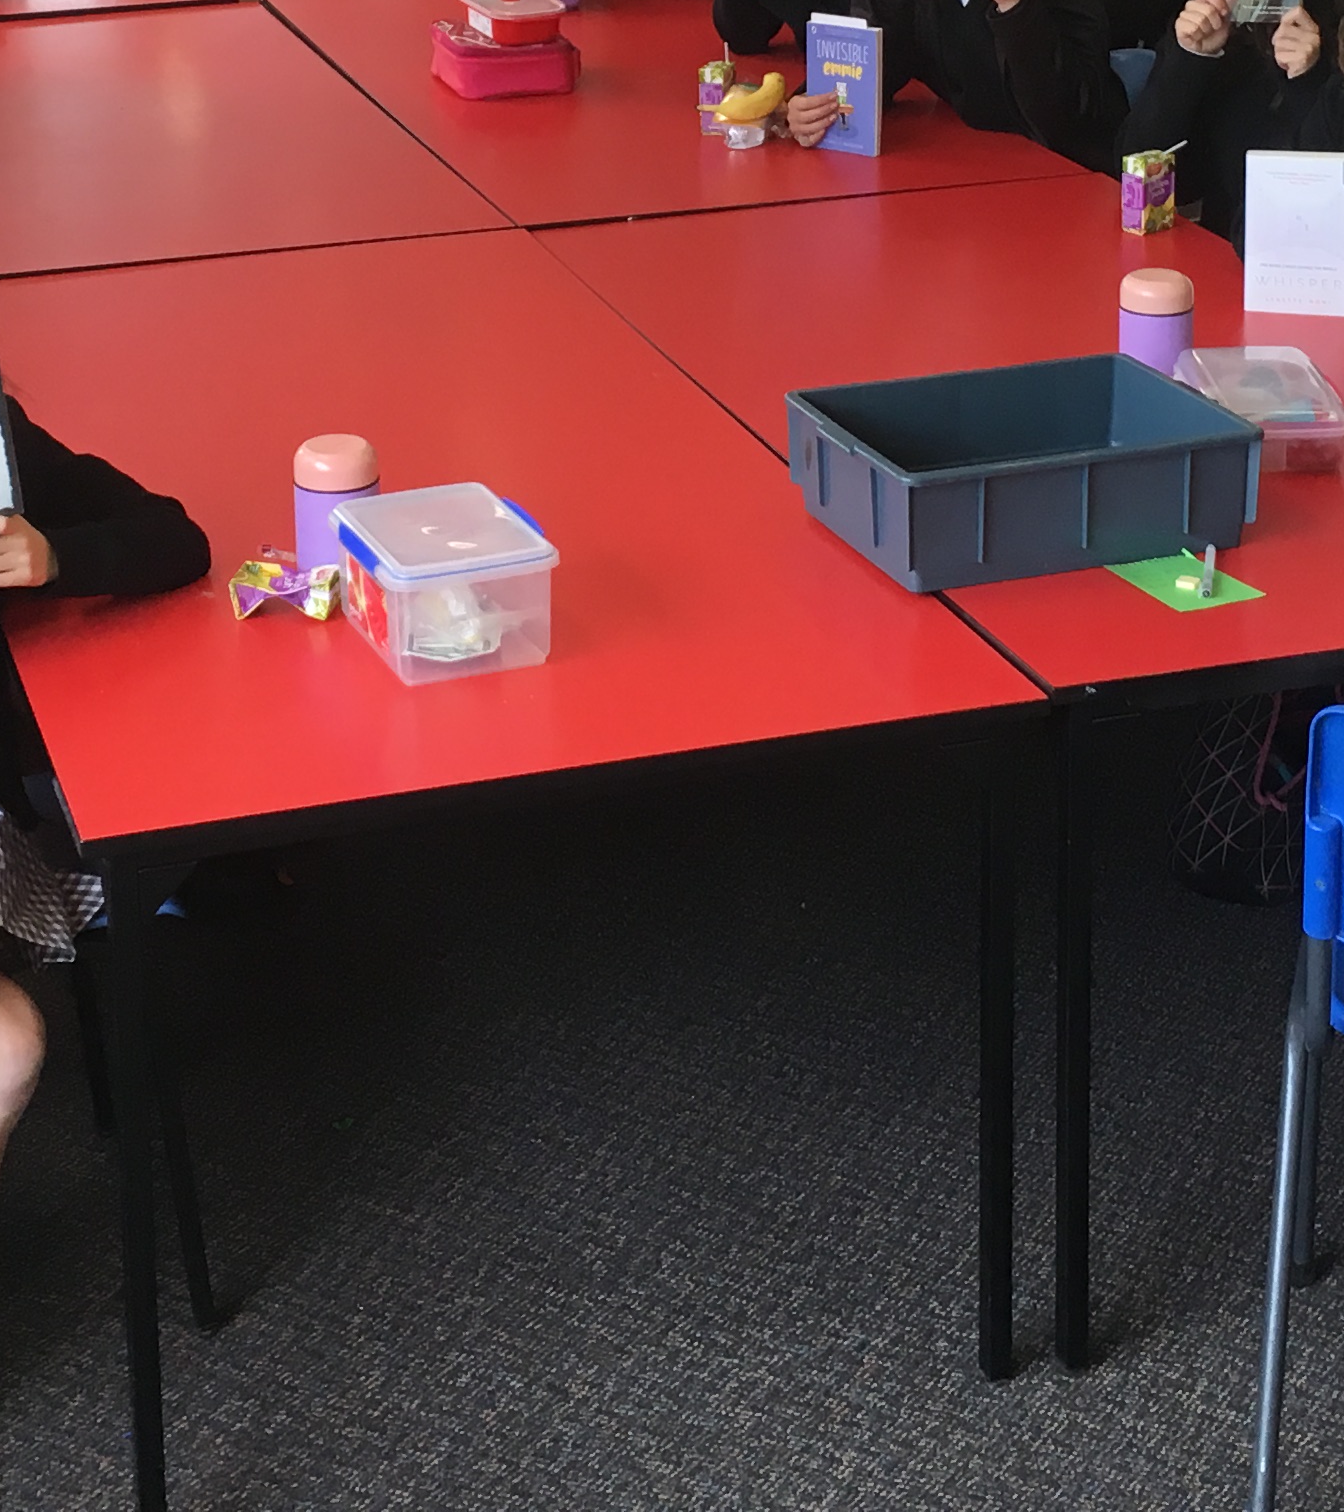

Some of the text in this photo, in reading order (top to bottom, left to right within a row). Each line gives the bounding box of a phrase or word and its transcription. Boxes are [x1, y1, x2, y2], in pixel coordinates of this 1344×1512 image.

[816, 38, 869, 65] INVISIBLE
[822, 61, 863, 81] emmie
[1255, 274, 1343, 289] WHISPER
